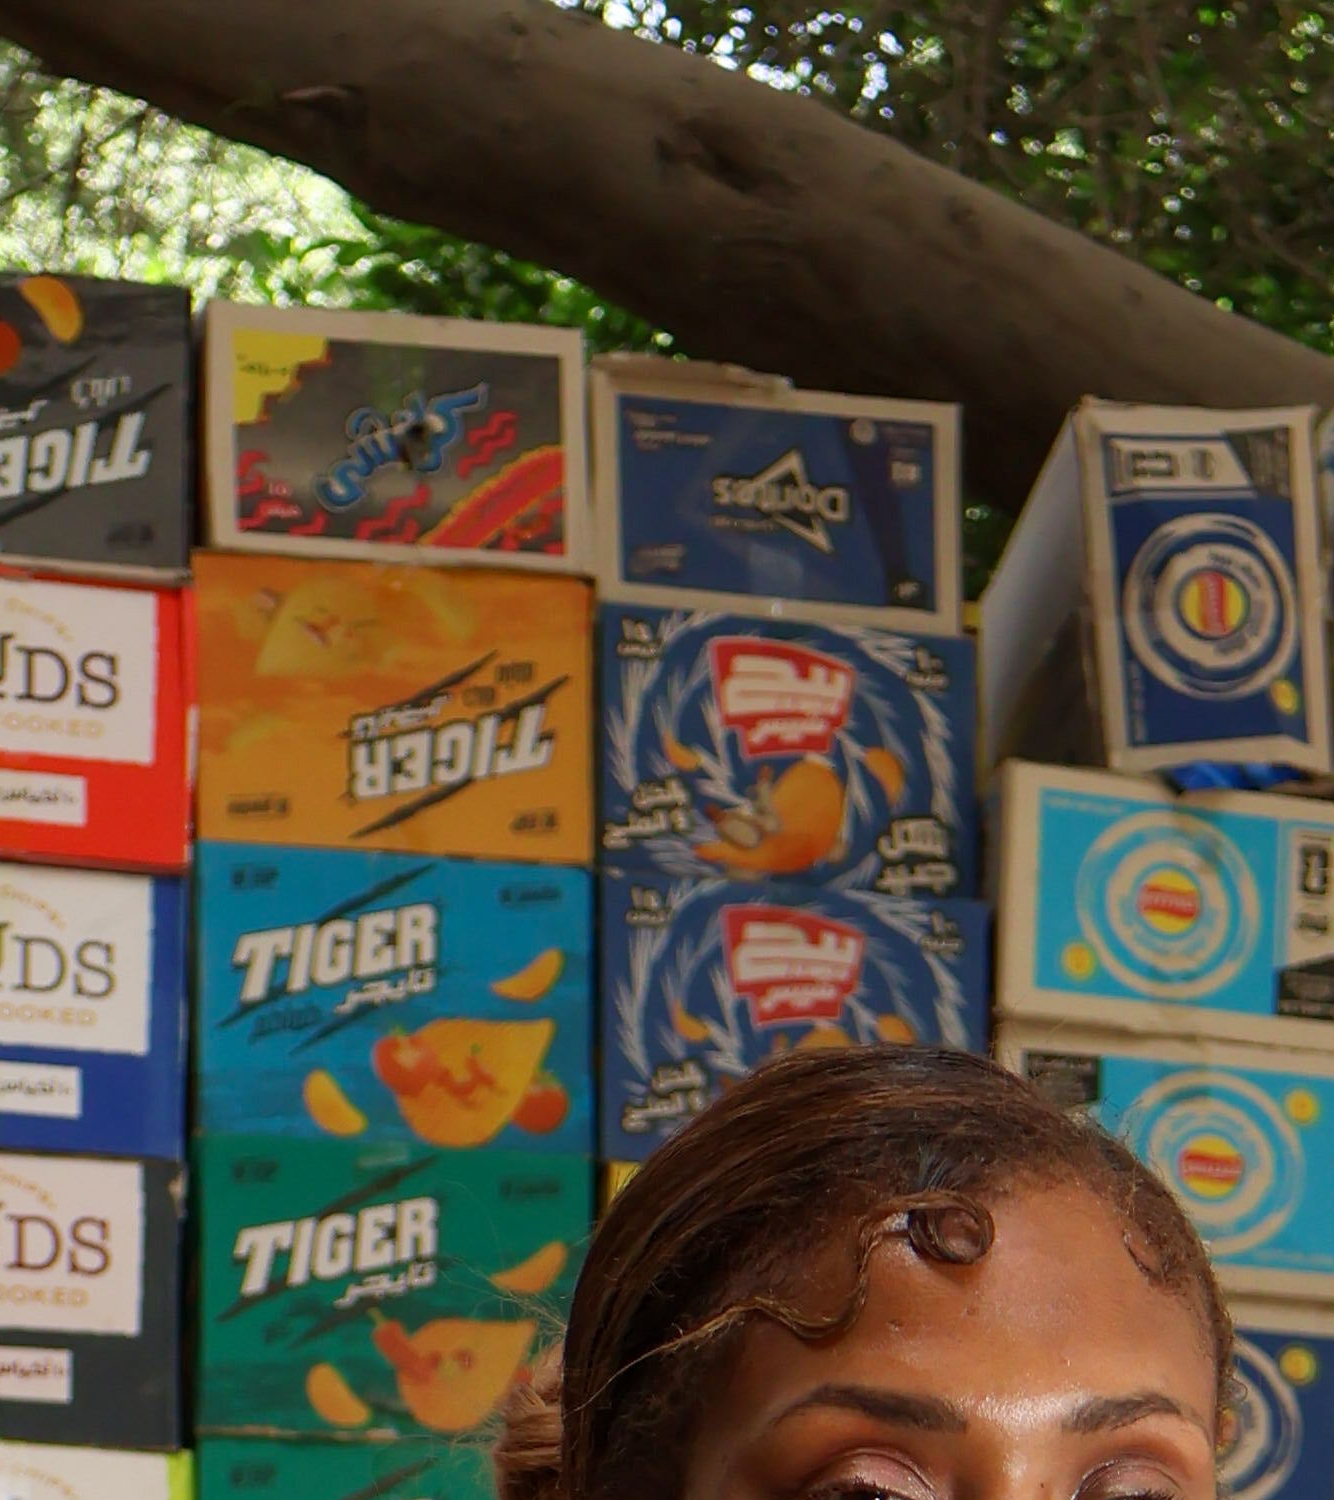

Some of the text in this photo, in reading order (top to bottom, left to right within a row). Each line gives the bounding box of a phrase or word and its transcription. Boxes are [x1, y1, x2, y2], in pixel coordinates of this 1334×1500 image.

[349, 699, 555, 801] TIGER
[231, 902, 441, 1001] TIGER
[233, 1197, 441, 1298] TIGER
